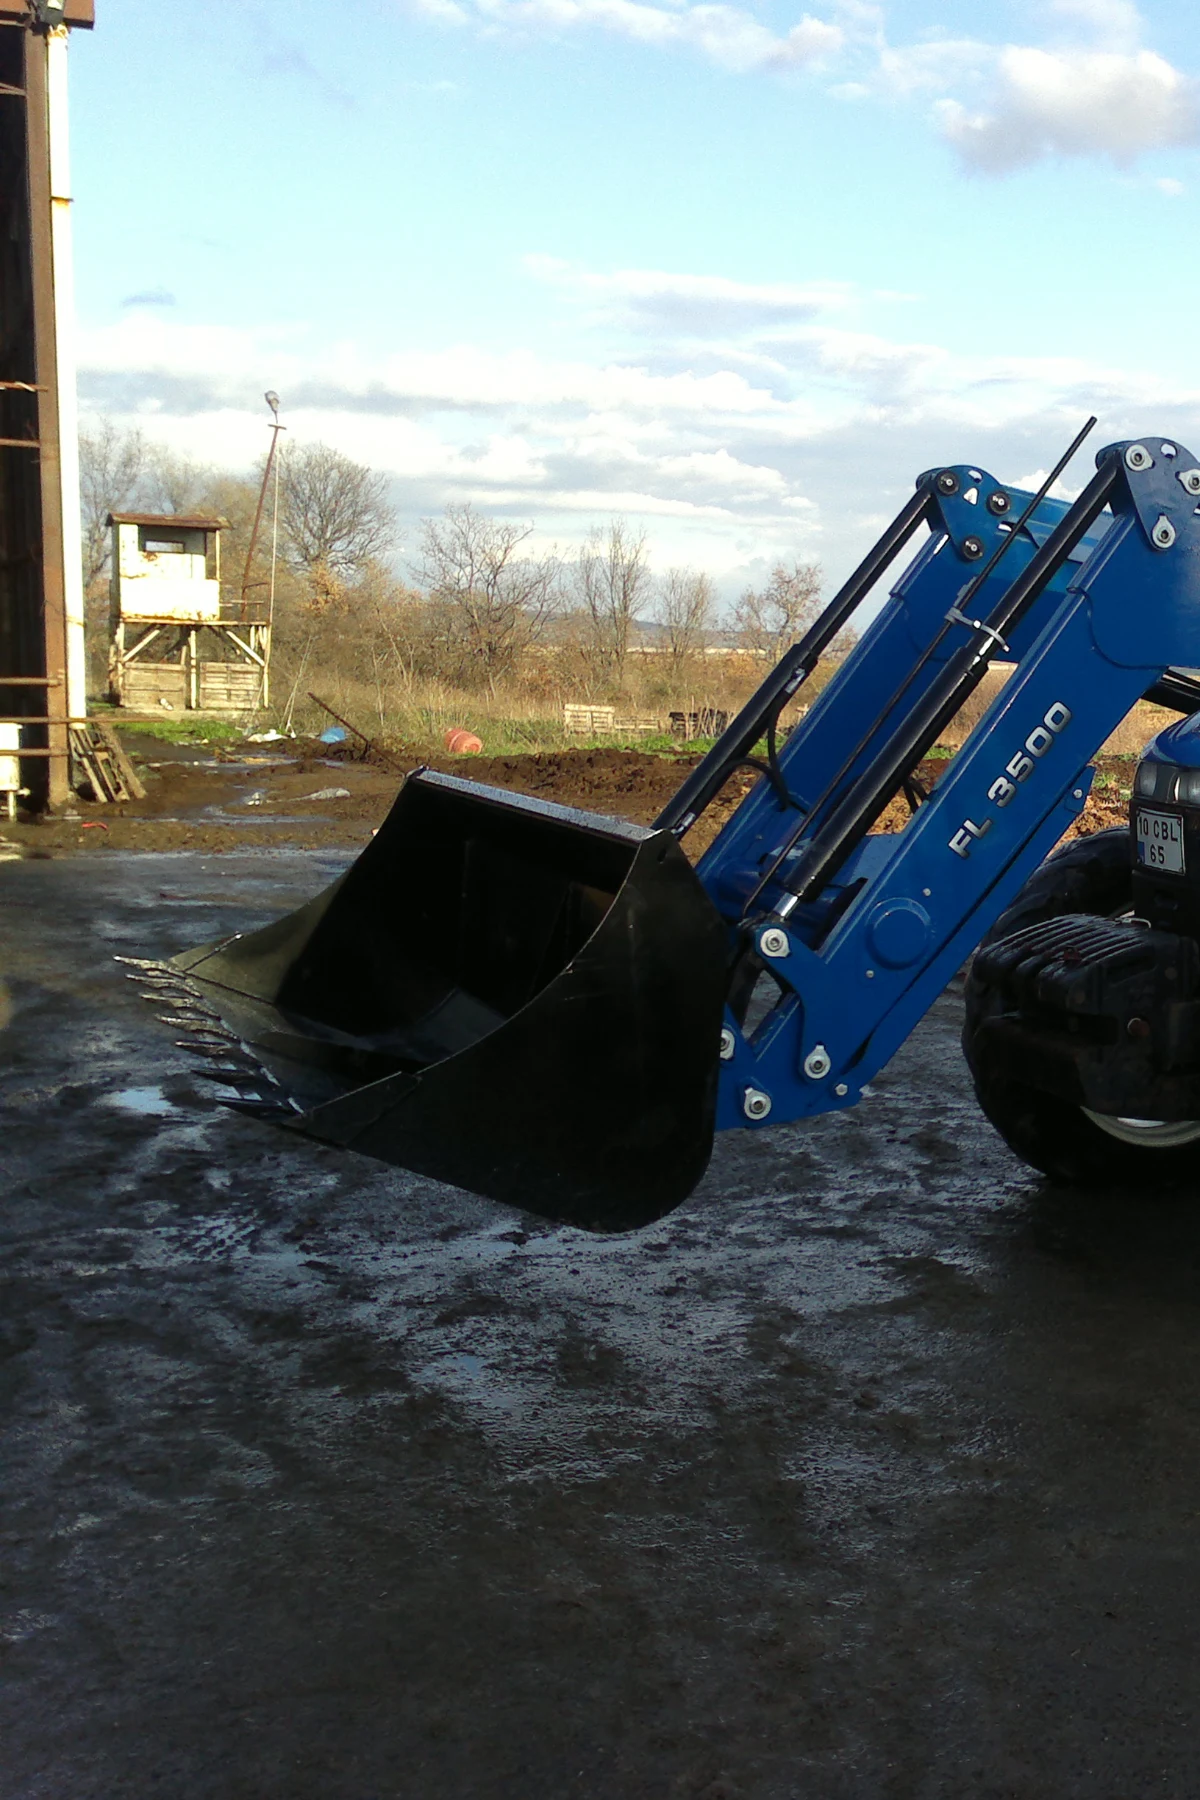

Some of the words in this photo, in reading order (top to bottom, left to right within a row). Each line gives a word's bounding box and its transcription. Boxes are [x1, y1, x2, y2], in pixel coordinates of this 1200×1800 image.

[948, 817, 993, 859] FL
[987, 701, 1072, 808] 3500
[1139, 816, 1149, 836] 10
[1153, 820, 1179, 842] CBL
[1150, 844, 1165, 865] 65
